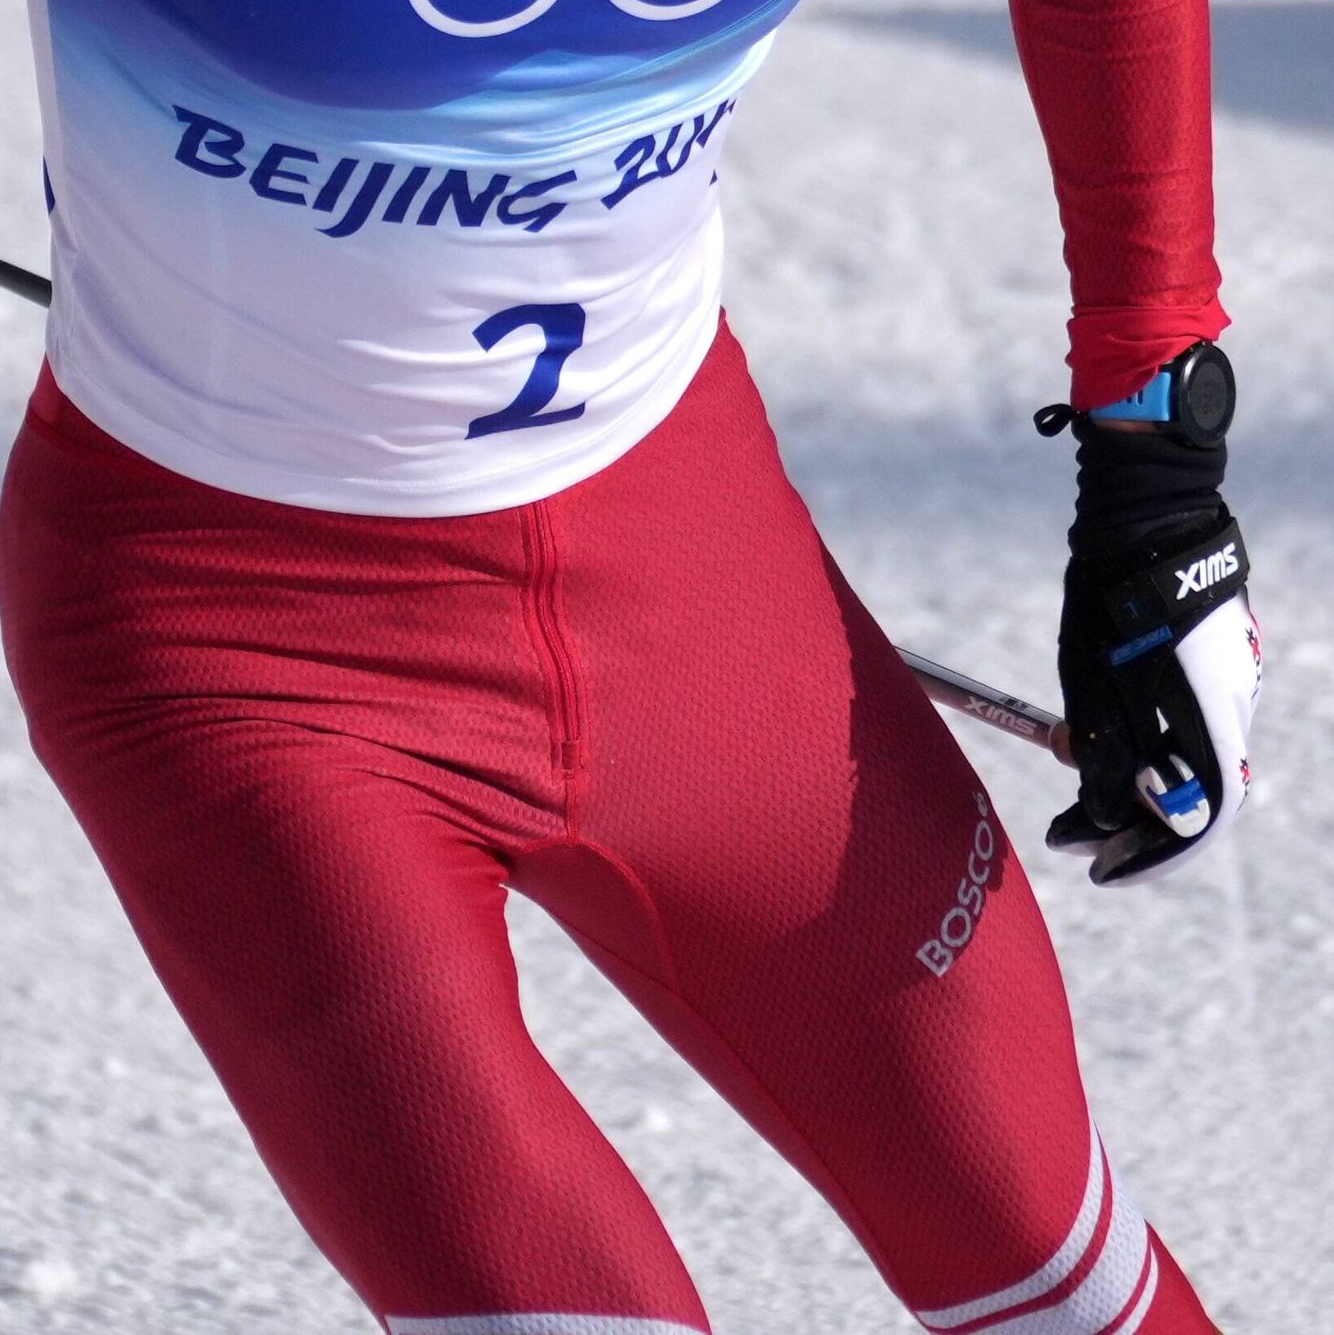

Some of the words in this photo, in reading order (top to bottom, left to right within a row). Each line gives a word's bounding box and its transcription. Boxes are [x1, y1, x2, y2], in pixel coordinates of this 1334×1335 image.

[172, 105, 576, 238] BEIJING
[600, 98, 736, 210] 20
[465, 302, 586, 441] 2
[1174, 542, 1239, 600] SWIX
[915, 819, 994, 978] BOSCO
